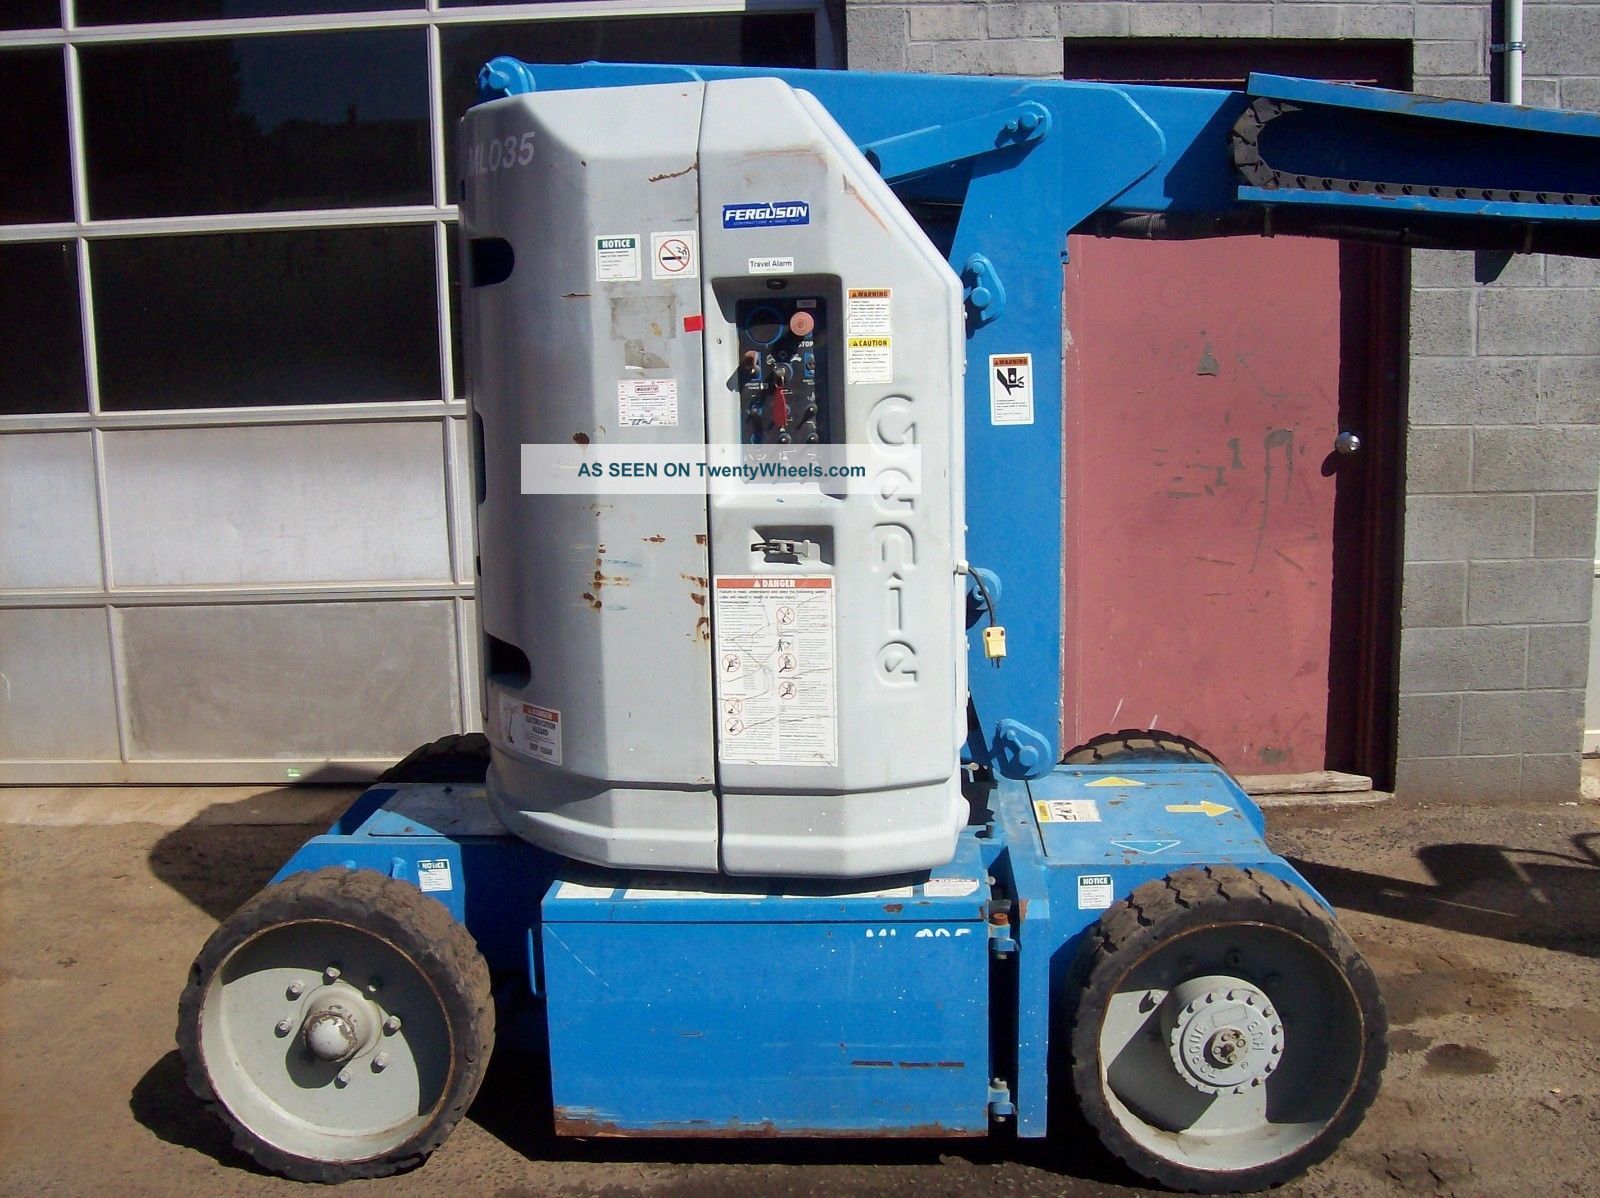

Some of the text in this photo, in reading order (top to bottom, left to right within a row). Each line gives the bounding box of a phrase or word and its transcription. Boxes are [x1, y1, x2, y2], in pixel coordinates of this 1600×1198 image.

[725, 206, 808, 221] FERGUSON
[602, 239, 631, 249] NOTICE
[750, 260, 771, 268] Travel
[857, 290, 888, 298] WARNING
[859, 339, 888, 347] CAUTION
[762, 579, 796, 588] DANGER
[1082, 877, 1108, 885] NOTICE
